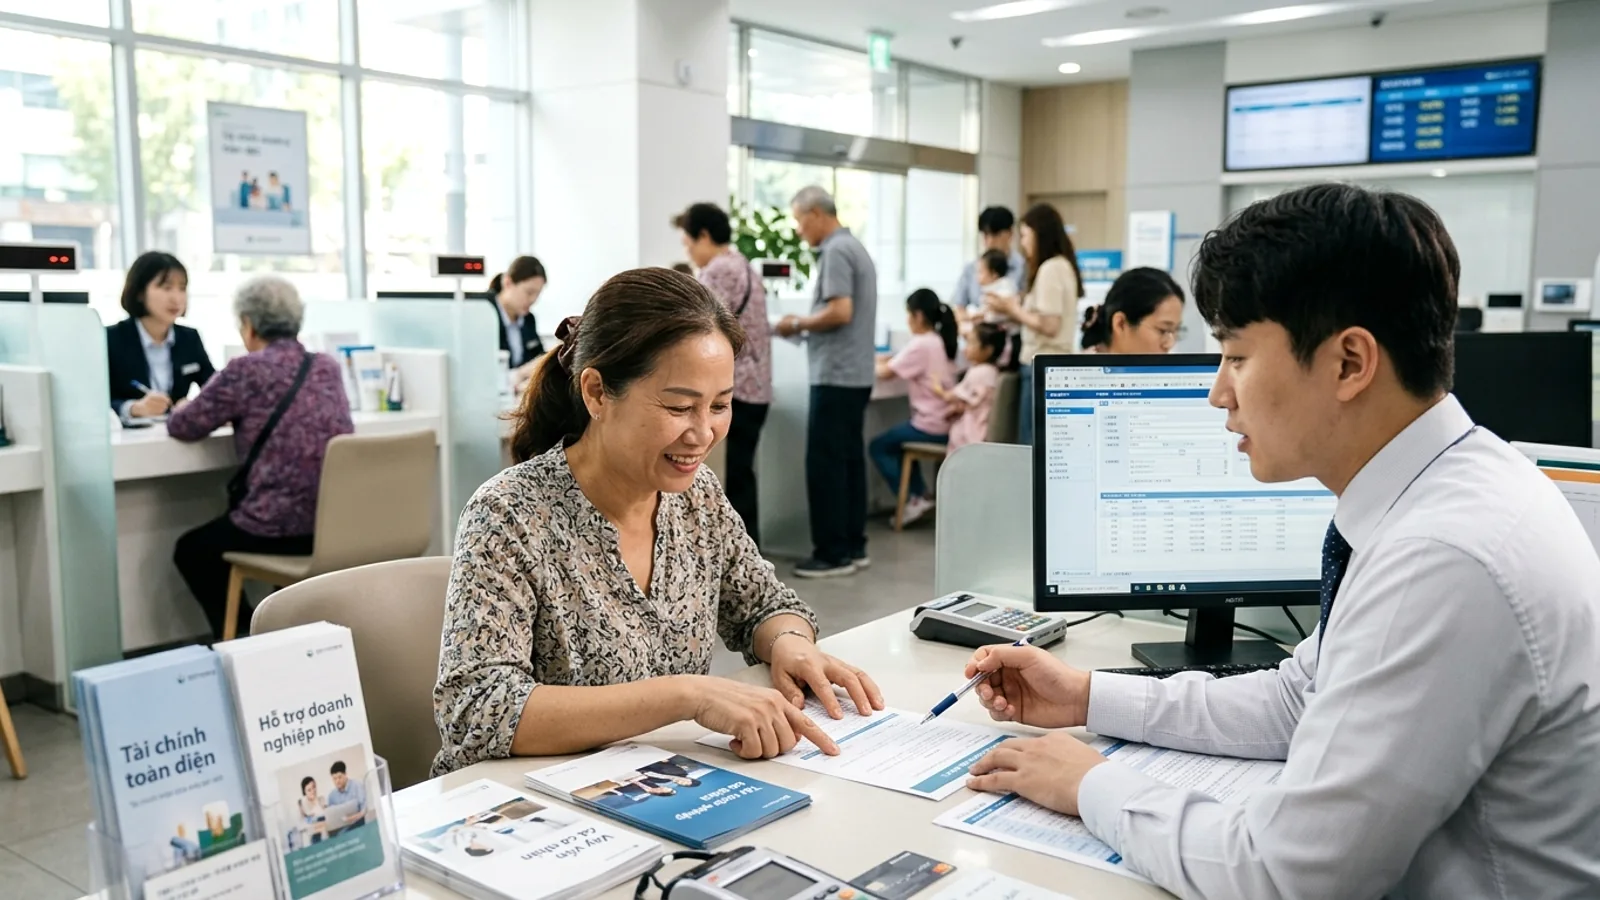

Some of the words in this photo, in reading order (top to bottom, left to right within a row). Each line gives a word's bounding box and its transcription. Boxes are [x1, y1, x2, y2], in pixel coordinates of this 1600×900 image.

[259, 710, 281, 732] Hỗ
[283, 707, 305, 724] trợ
[308, 693, 353, 717] doanh
[119, 740, 150, 763] Tài
[155, 727, 207, 754] chính
[263, 728, 315, 753] nghiệp
[318, 714, 345, 736] nhỏ
[125, 765, 170, 788] toàn
[175, 751, 216, 774] diện
